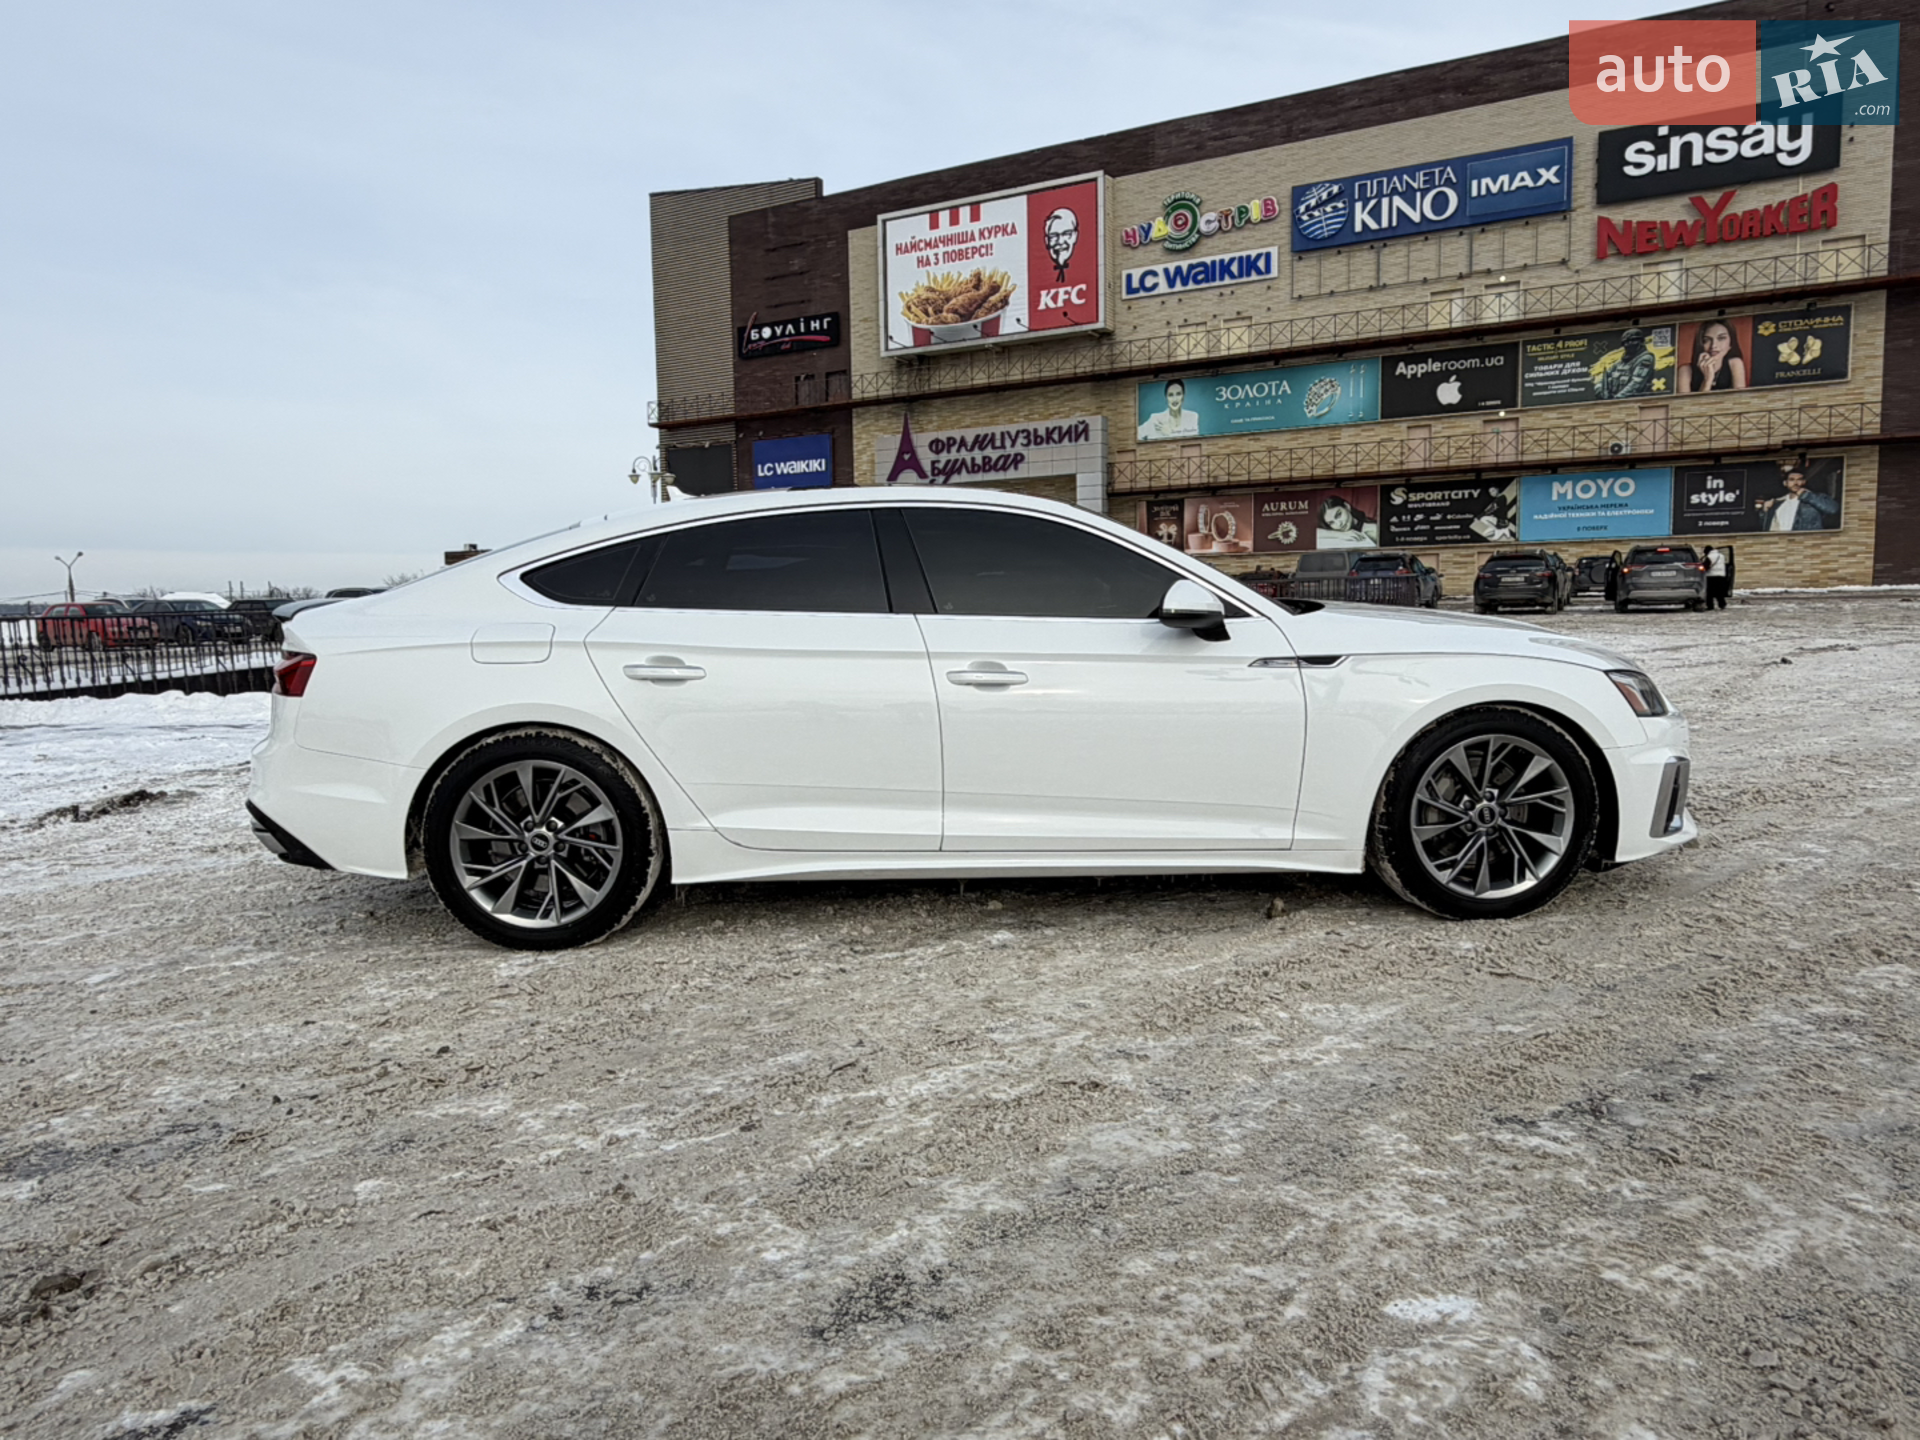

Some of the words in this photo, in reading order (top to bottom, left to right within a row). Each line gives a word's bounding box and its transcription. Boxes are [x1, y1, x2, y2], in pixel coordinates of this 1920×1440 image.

[1622, 112, 1815, 177] sinsay
[1471, 165, 1561, 197] IMAX
[1354, 187, 1459, 233] KINO
[895, 229, 976, 256] НАЙСМАЧНІША
[978, 222, 1018, 241] КУРКА
[916, 255, 932, 269] НА
[933, 252, 940, 266] 3
[942, 243, 994, 264] ПОВЕРСІ!
[1126, 270, 1160, 295] LC
[1037, 284, 1087, 310] KFC
[1526, 342, 1556, 353] TACTIC
[1556, 340, 1564, 349] 4
[1564, 338, 1588, 348] PROFI
[1394, 355, 1505, 379] Appleroom.ua
[1524, 370, 1560, 379] СИЛЬНИХ
[1561, 367, 1588, 376] ДУХОМ
[1533, 363, 1564, 372] ТОВАРИ
[1564, 361, 1581, 369] ДЛЯ
[1215, 380, 1292, 401] ЗОЛОТА
[928, 420, 1090, 454] ФРАНЦУЗЬКИЙ
[757, 463, 774, 477] LC
[1706, 475, 1725, 489] in
[1551, 477, 1636, 501] MOYO
[1262, 500, 1309, 512] AURUM
